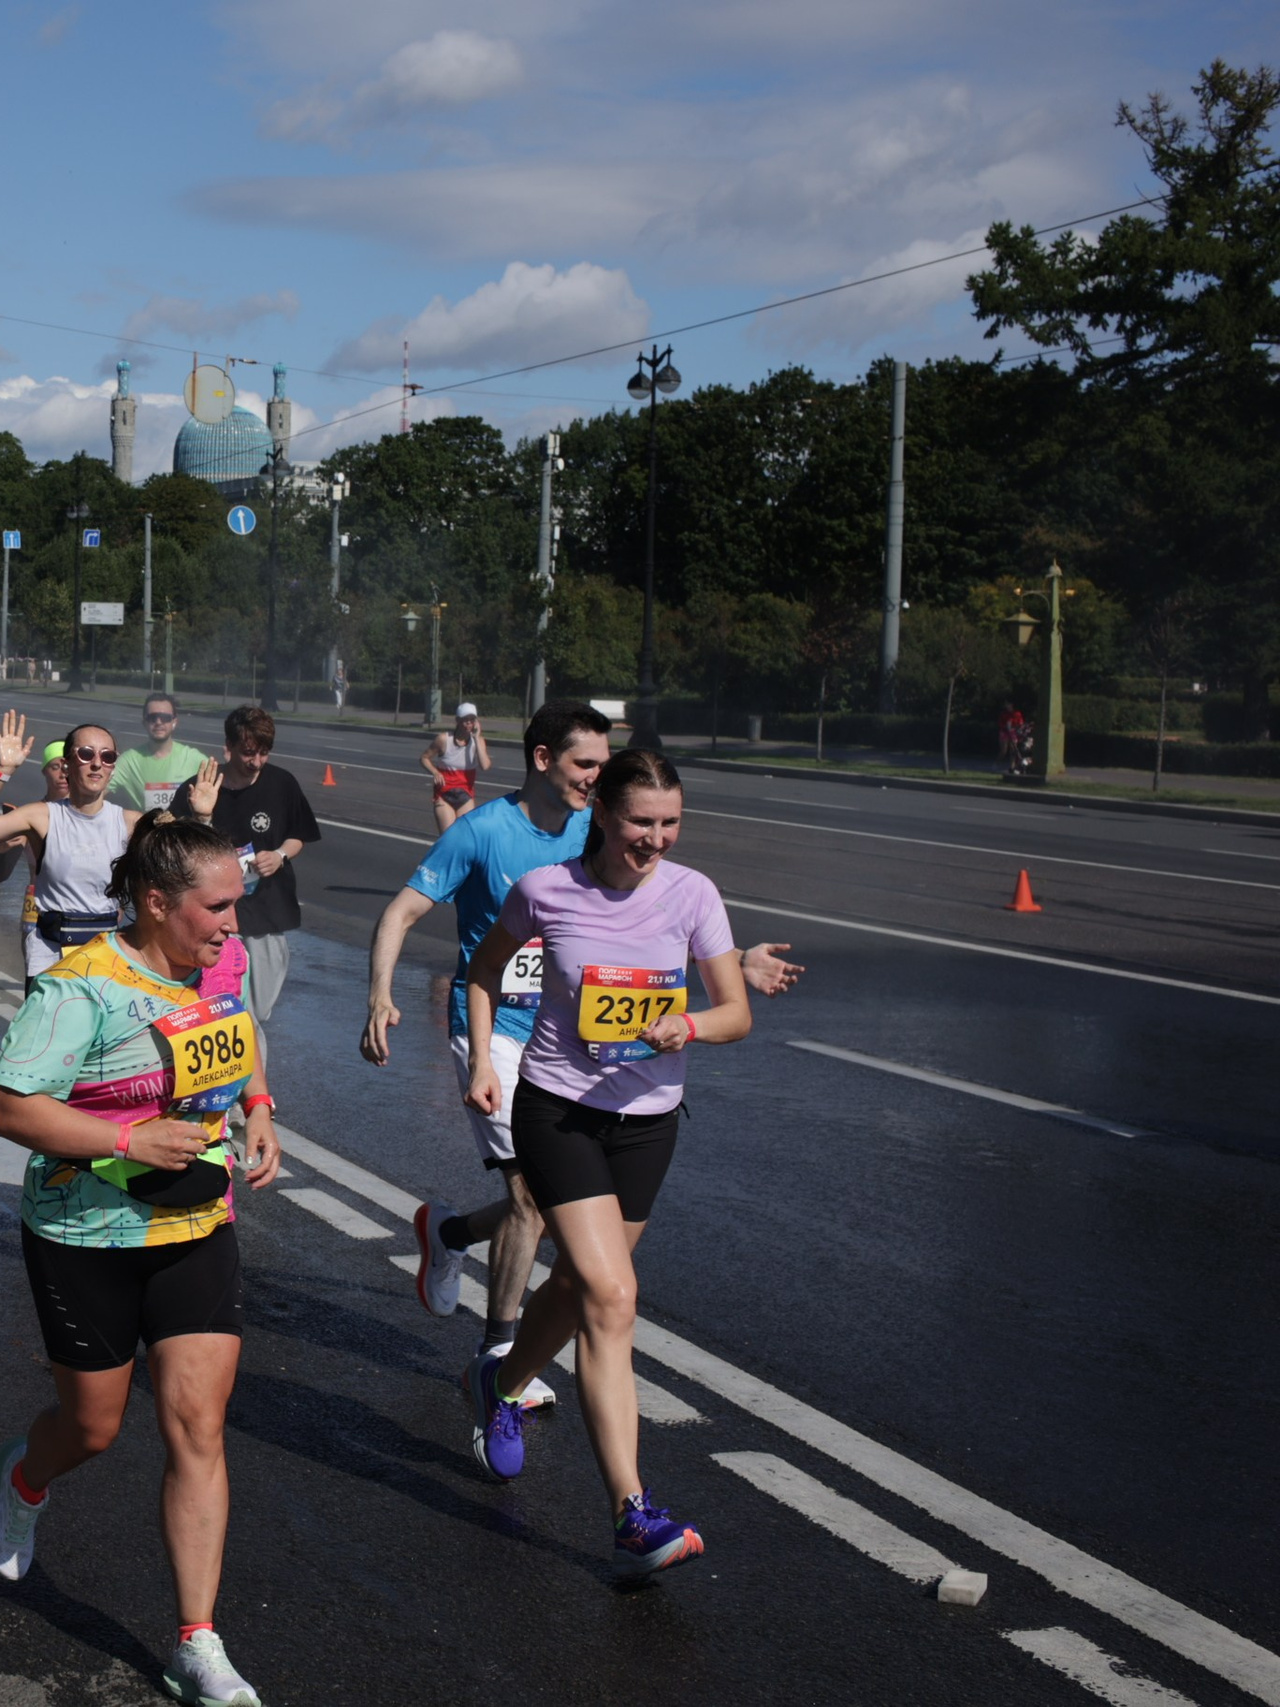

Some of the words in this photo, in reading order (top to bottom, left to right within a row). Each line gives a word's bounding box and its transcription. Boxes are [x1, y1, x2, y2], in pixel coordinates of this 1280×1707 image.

[514, 954, 543, 979] 52
[598, 967, 618, 975] ПОЛУ
[598, 974, 633, 982] МАРАФОН
[647, 975, 663, 984] 21,1
[506, 994, 519, 1005] D
[166, 1011, 184, 1022] ПОЛУ
[208, 1004, 222, 1015] 21,1
[594, 995, 675, 1025] 2317
[171, 1012, 200, 1027] МАРАФОН
[184, 1024, 245, 1075] 3986
[588, 1043, 600, 1059] E
[192, 1062, 243, 1088] АЛЕКСАНДРА
[177, 1097, 193, 1112] E
